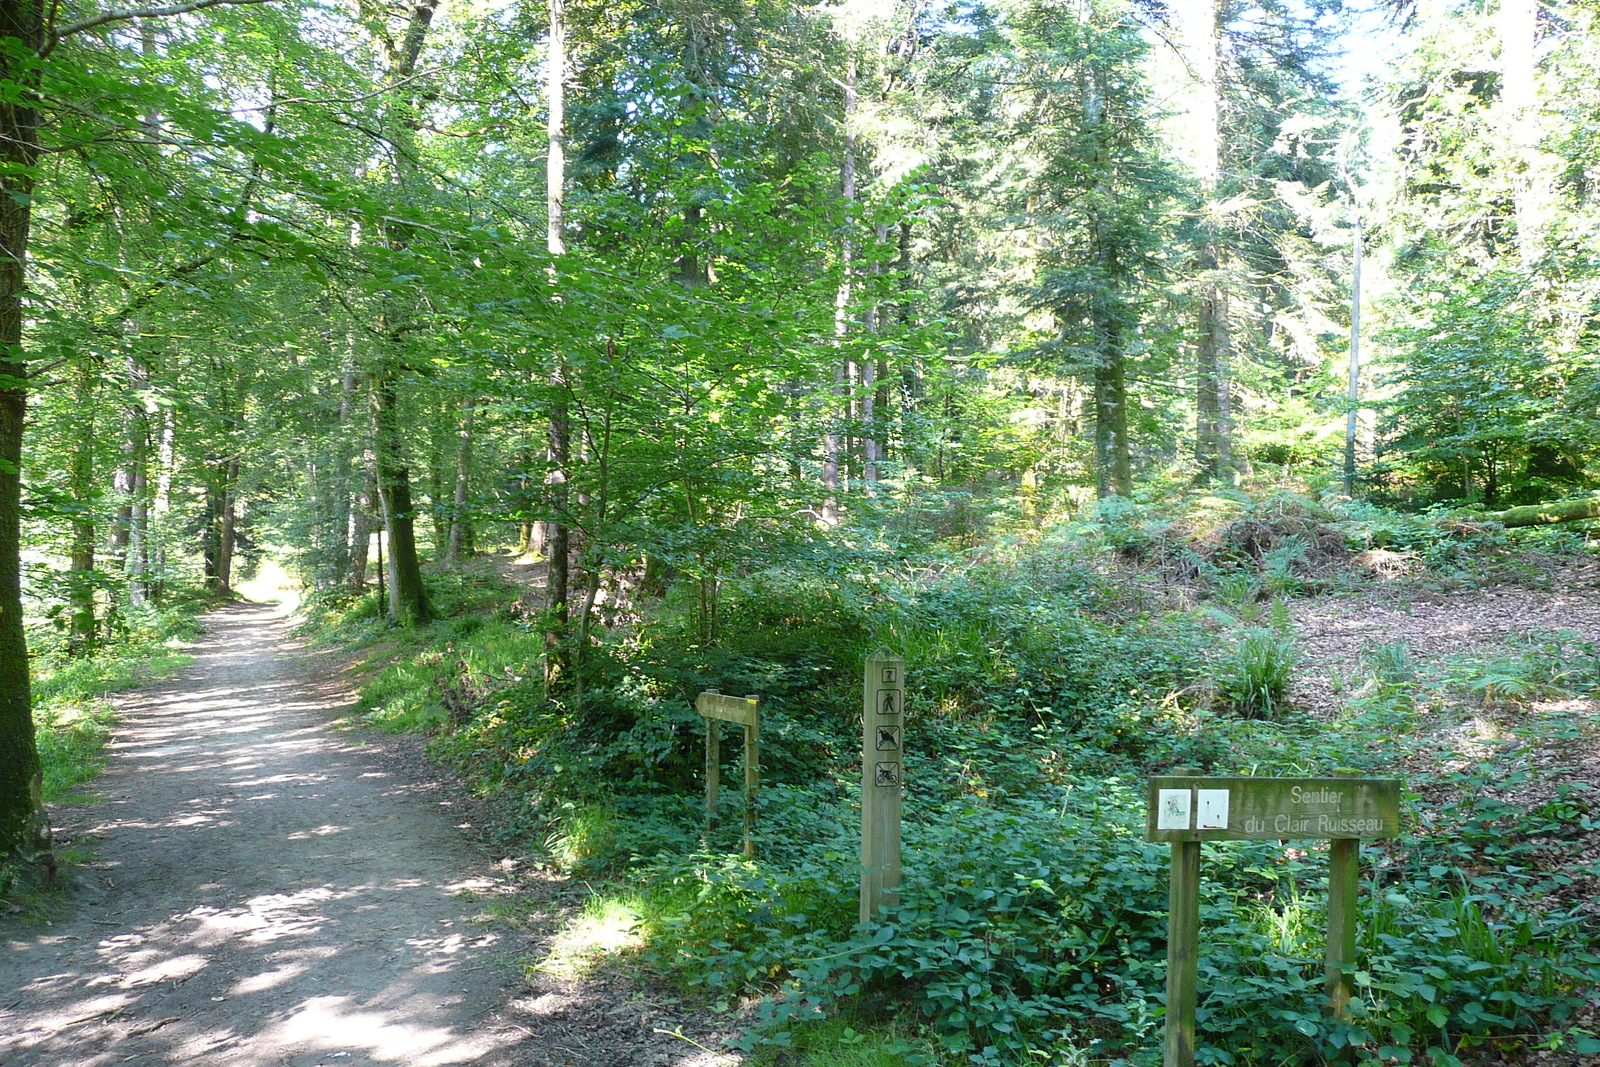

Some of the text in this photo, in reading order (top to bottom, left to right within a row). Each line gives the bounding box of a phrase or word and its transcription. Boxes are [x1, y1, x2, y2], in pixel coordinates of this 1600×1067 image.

[886, 670, 893, 681] 7
[1291, 785, 1343, 804] Sentier
[1244, 814, 1383, 833] du Clair Ruisseau
